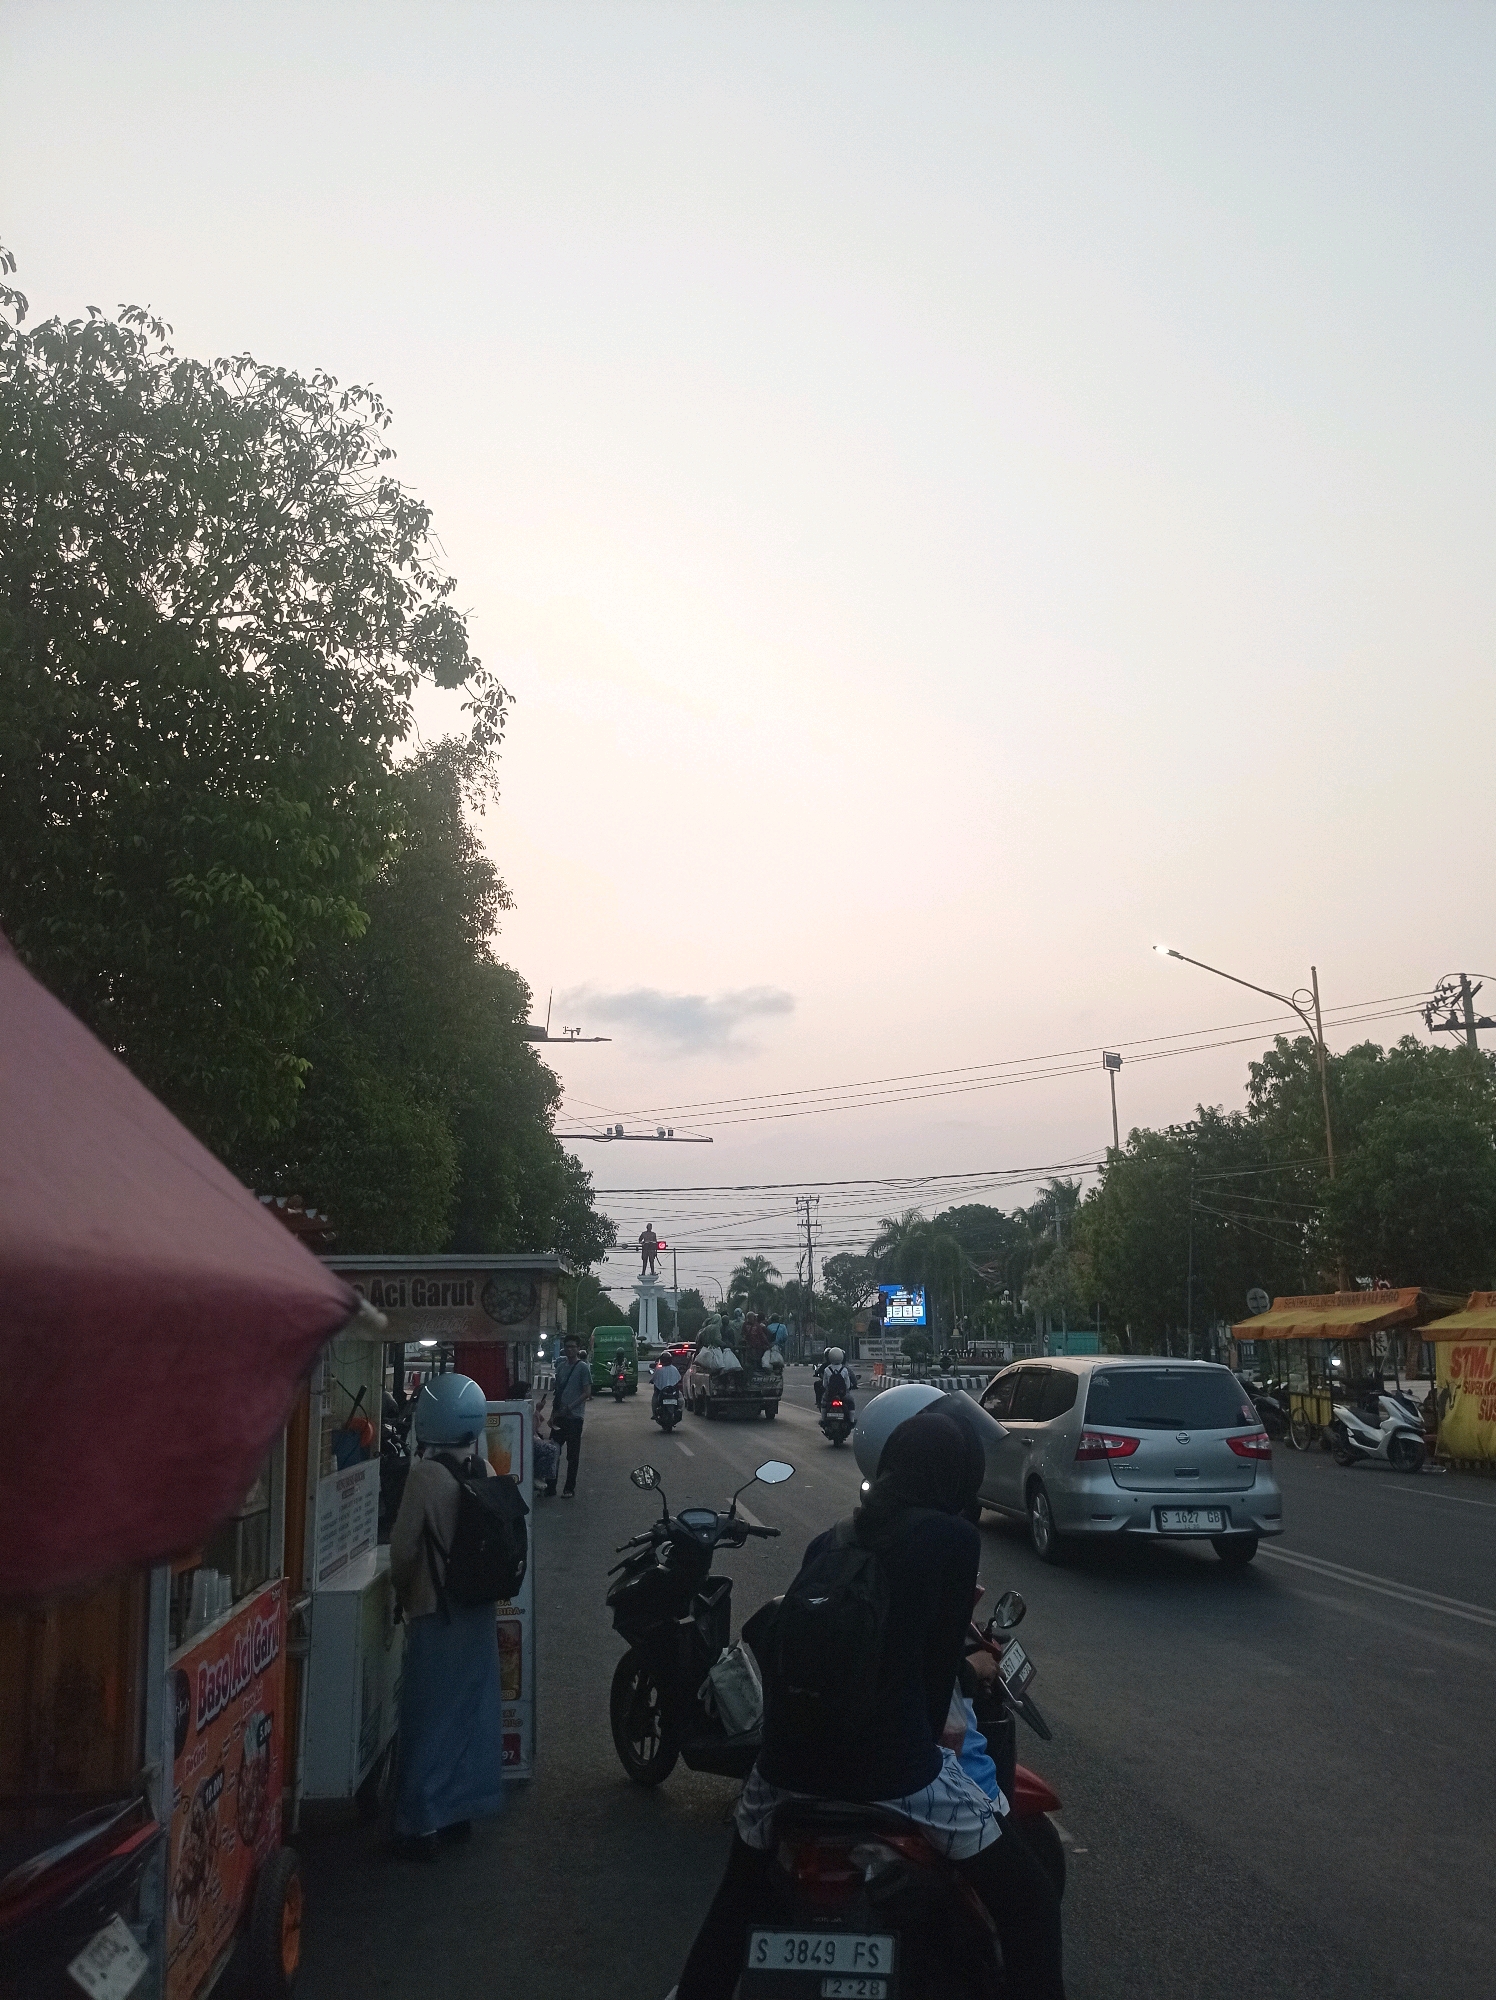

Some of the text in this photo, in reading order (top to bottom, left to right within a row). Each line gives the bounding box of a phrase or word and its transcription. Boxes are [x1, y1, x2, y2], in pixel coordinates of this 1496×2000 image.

[370, 1279, 406, 1308] Aci
[411, 1278, 474, 1307] Garut
[1450, 1345, 1496, 1379] STMJ
[1463, 1380, 1496, 1396] SUPER KO
[1161, 1511, 1220, 1523] S 1627 GB
[197, 1659, 231, 1733] Baso
[231, 1617, 252, 1695] Aci
[757, 1938, 879, 1968] S 3849 FS
